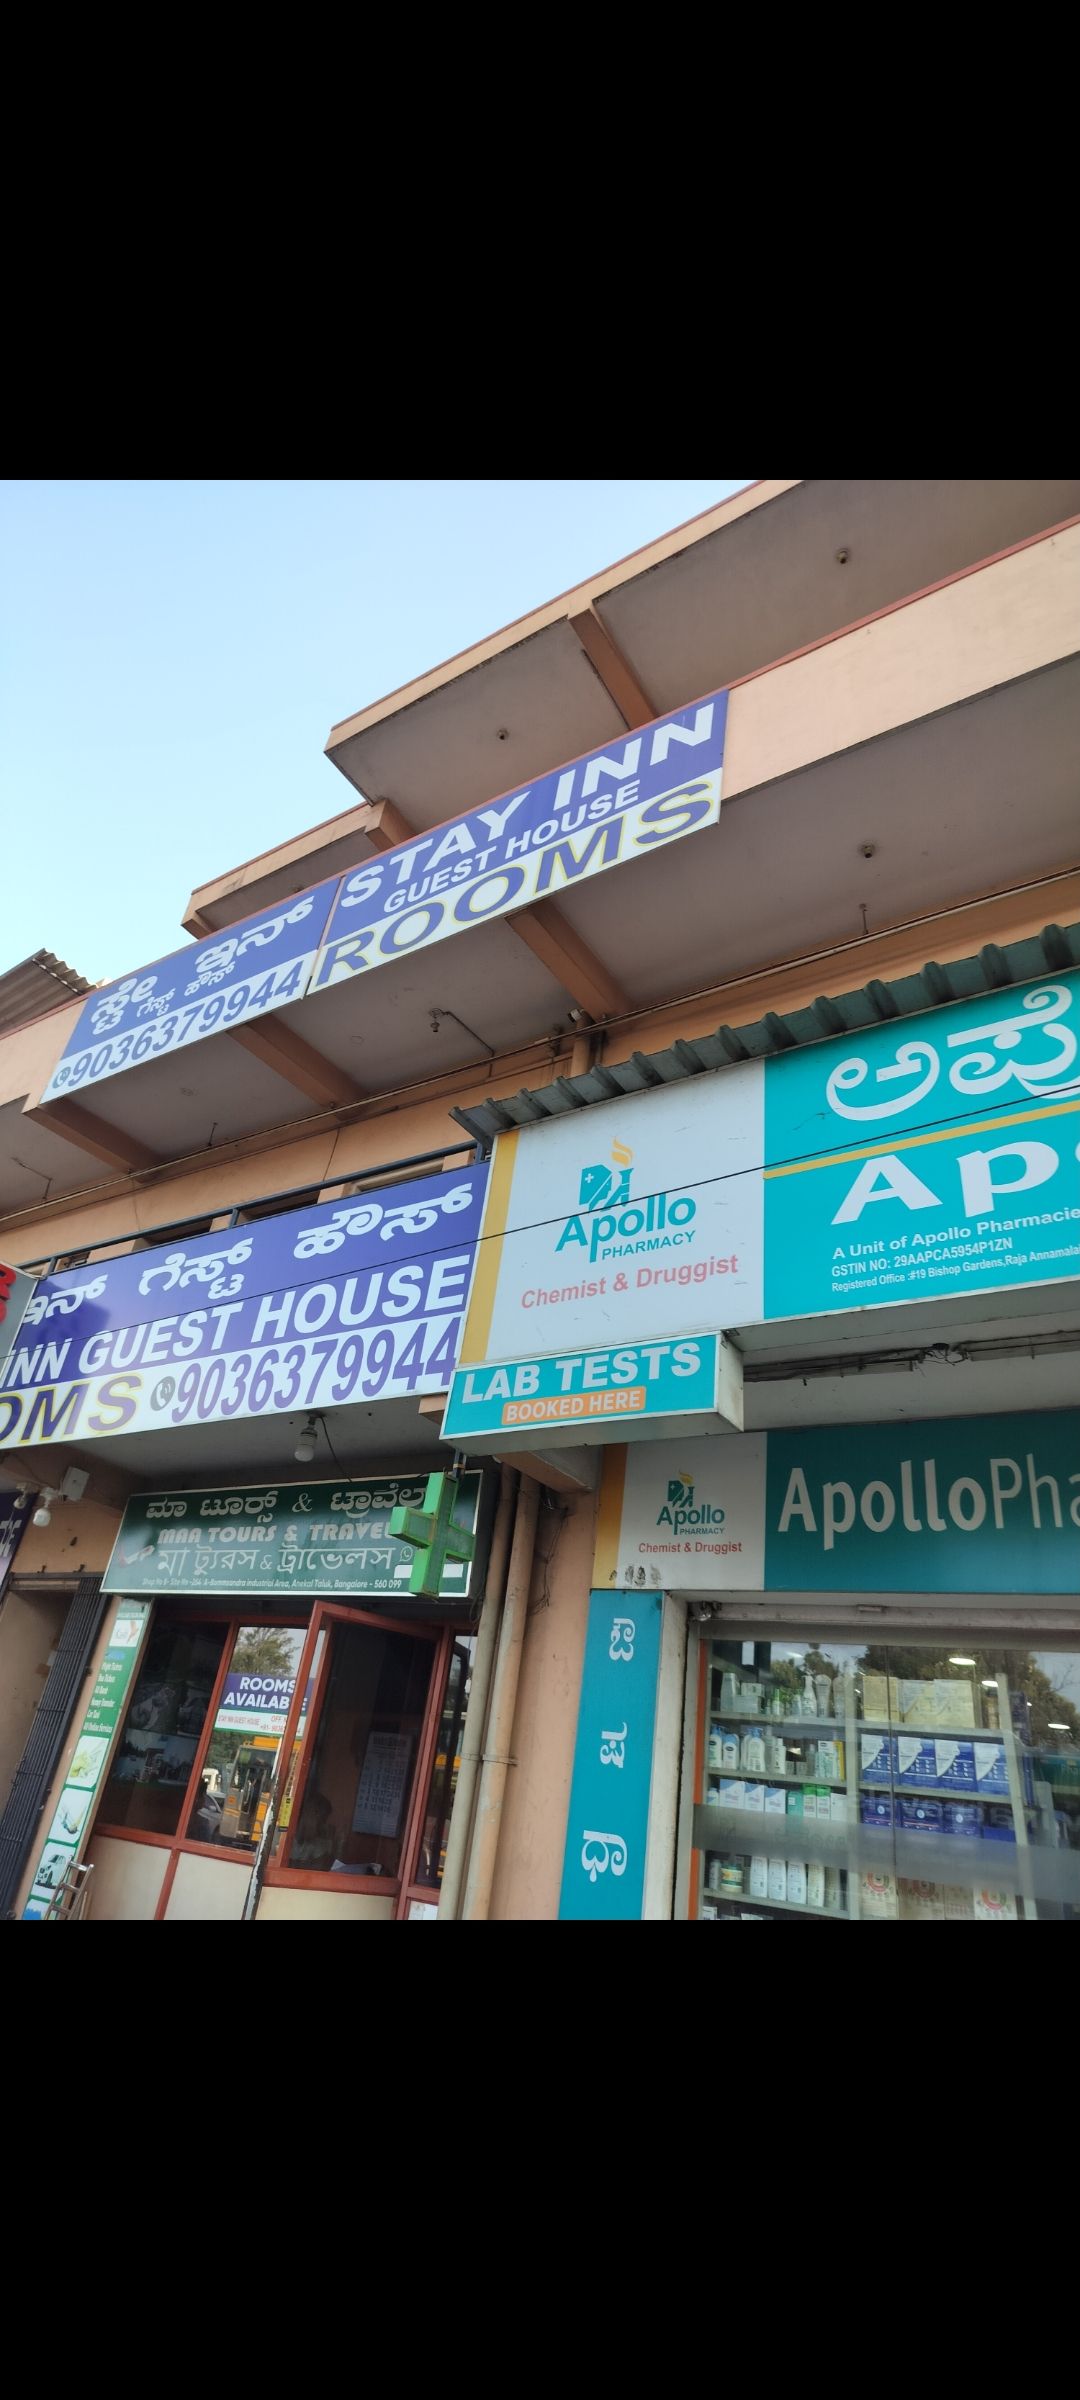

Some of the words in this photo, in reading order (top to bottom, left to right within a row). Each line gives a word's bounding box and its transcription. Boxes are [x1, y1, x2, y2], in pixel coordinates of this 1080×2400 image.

[340, 791, 531, 908] STAY
[552, 703, 717, 812] INN
[383, 852, 489, 914] GUEST
[505, 780, 642, 859] HOUSE
[318, 780, 716, 987] ROOMS
[90, 976, 158, 1036] ಸ್ಟೇ
[195, 896, 314, 973] ಇನ್
[67, 960, 305, 1088] 9036379944
[831, 1141, 1080, 1225] Ap
[138, 1237, 254, 1299] ಗೆಸ್ಟ್
[293, 1182, 473, 1260] ಹೌಸ್
[555, 1190, 697, 1264] Apollo
[601, 1230, 697, 1261] PHARMACY
[832, 1247, 846, 1260] A
[850, 1241, 885, 1257] Unit
[889, 1236, 908, 1250] of
[911, 1226, 971, 1247] Apollo
[521, 1275, 607, 1311] Chemist
[613, 1270, 630, 1293] &
[636, 1254, 739, 1290] Druggist
[832, 1260, 867, 1277] GSTIN
[869, 1258, 891, 1272] NO:
[832, 1277, 878, 1293] Registered
[879, 1272, 905, 1285] Office
[927, 1264, 961, 1279] Bishop
[1029, 1245, 1080, 1262] Annamala
[0, 1338, 73, 1389] INN
[78, 1302, 242, 1375] GUEST
[250, 1254, 471, 1344] HOUSE
[171, 1321, 461, 1424] 9036379944
[462, 1362, 540, 1405] LAB
[556, 1342, 702, 1387] TESTS
[504, 1396, 584, 1425] BOOKED
[589, 1390, 642, 1414] HERE
[292, 1493, 313, 1513] &
[656, 1504, 725, 1535] Apollo
[157, 1527, 202, 1544] MAA
[208, 1525, 277, 1543] TOURS
[284, 1525, 297, 1541] &
[309, 1522, 391, 1541] TRAVEL
[638, 1542, 681, 1553] Chemist
[684, 1542, 692, 1553] &
[695, 1541, 743, 1555] Druggist
[680, 1527, 726, 1536] PHARMACY
[157, 1548, 190, 1577] মা
[260, 1555, 272, 1570] &
[334, 1580, 367, 1590] Bangalore
[374, 1580, 387, 1589] 560
[388, 1580, 402, 1590] 099
[224, 1692, 307, 1711] AVAILAB
[240, 1676, 296, 1693] ROOMS
